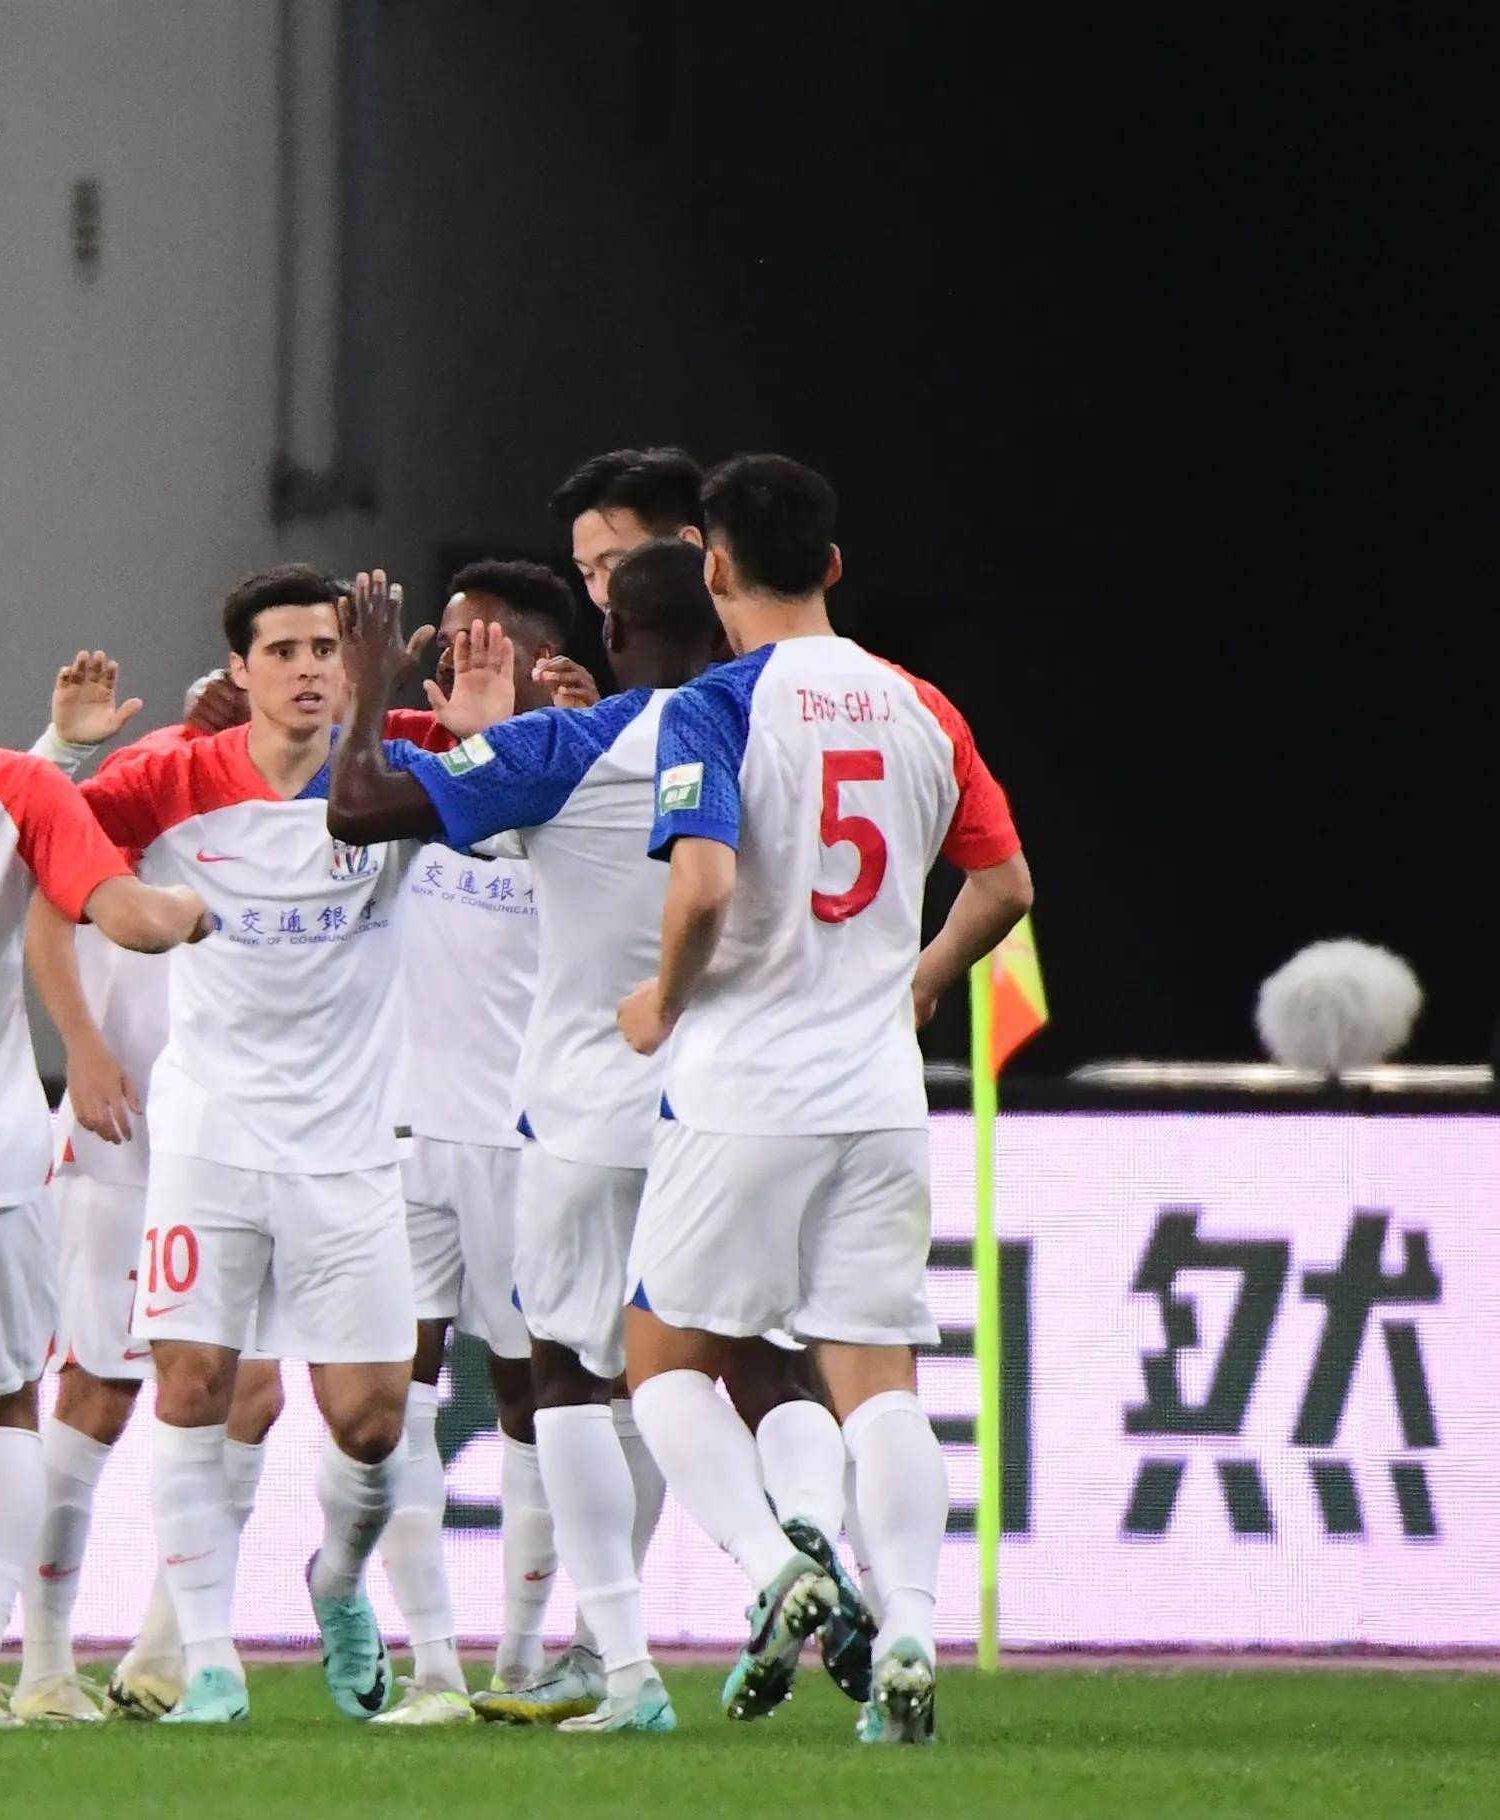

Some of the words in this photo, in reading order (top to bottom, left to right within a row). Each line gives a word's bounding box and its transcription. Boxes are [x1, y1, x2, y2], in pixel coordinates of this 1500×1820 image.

[811, 749, 887, 923] 5
[441, 889, 457, 901] OF
[267, 935, 282, 945] OF
[146, 1225, 199, 1293] 10
